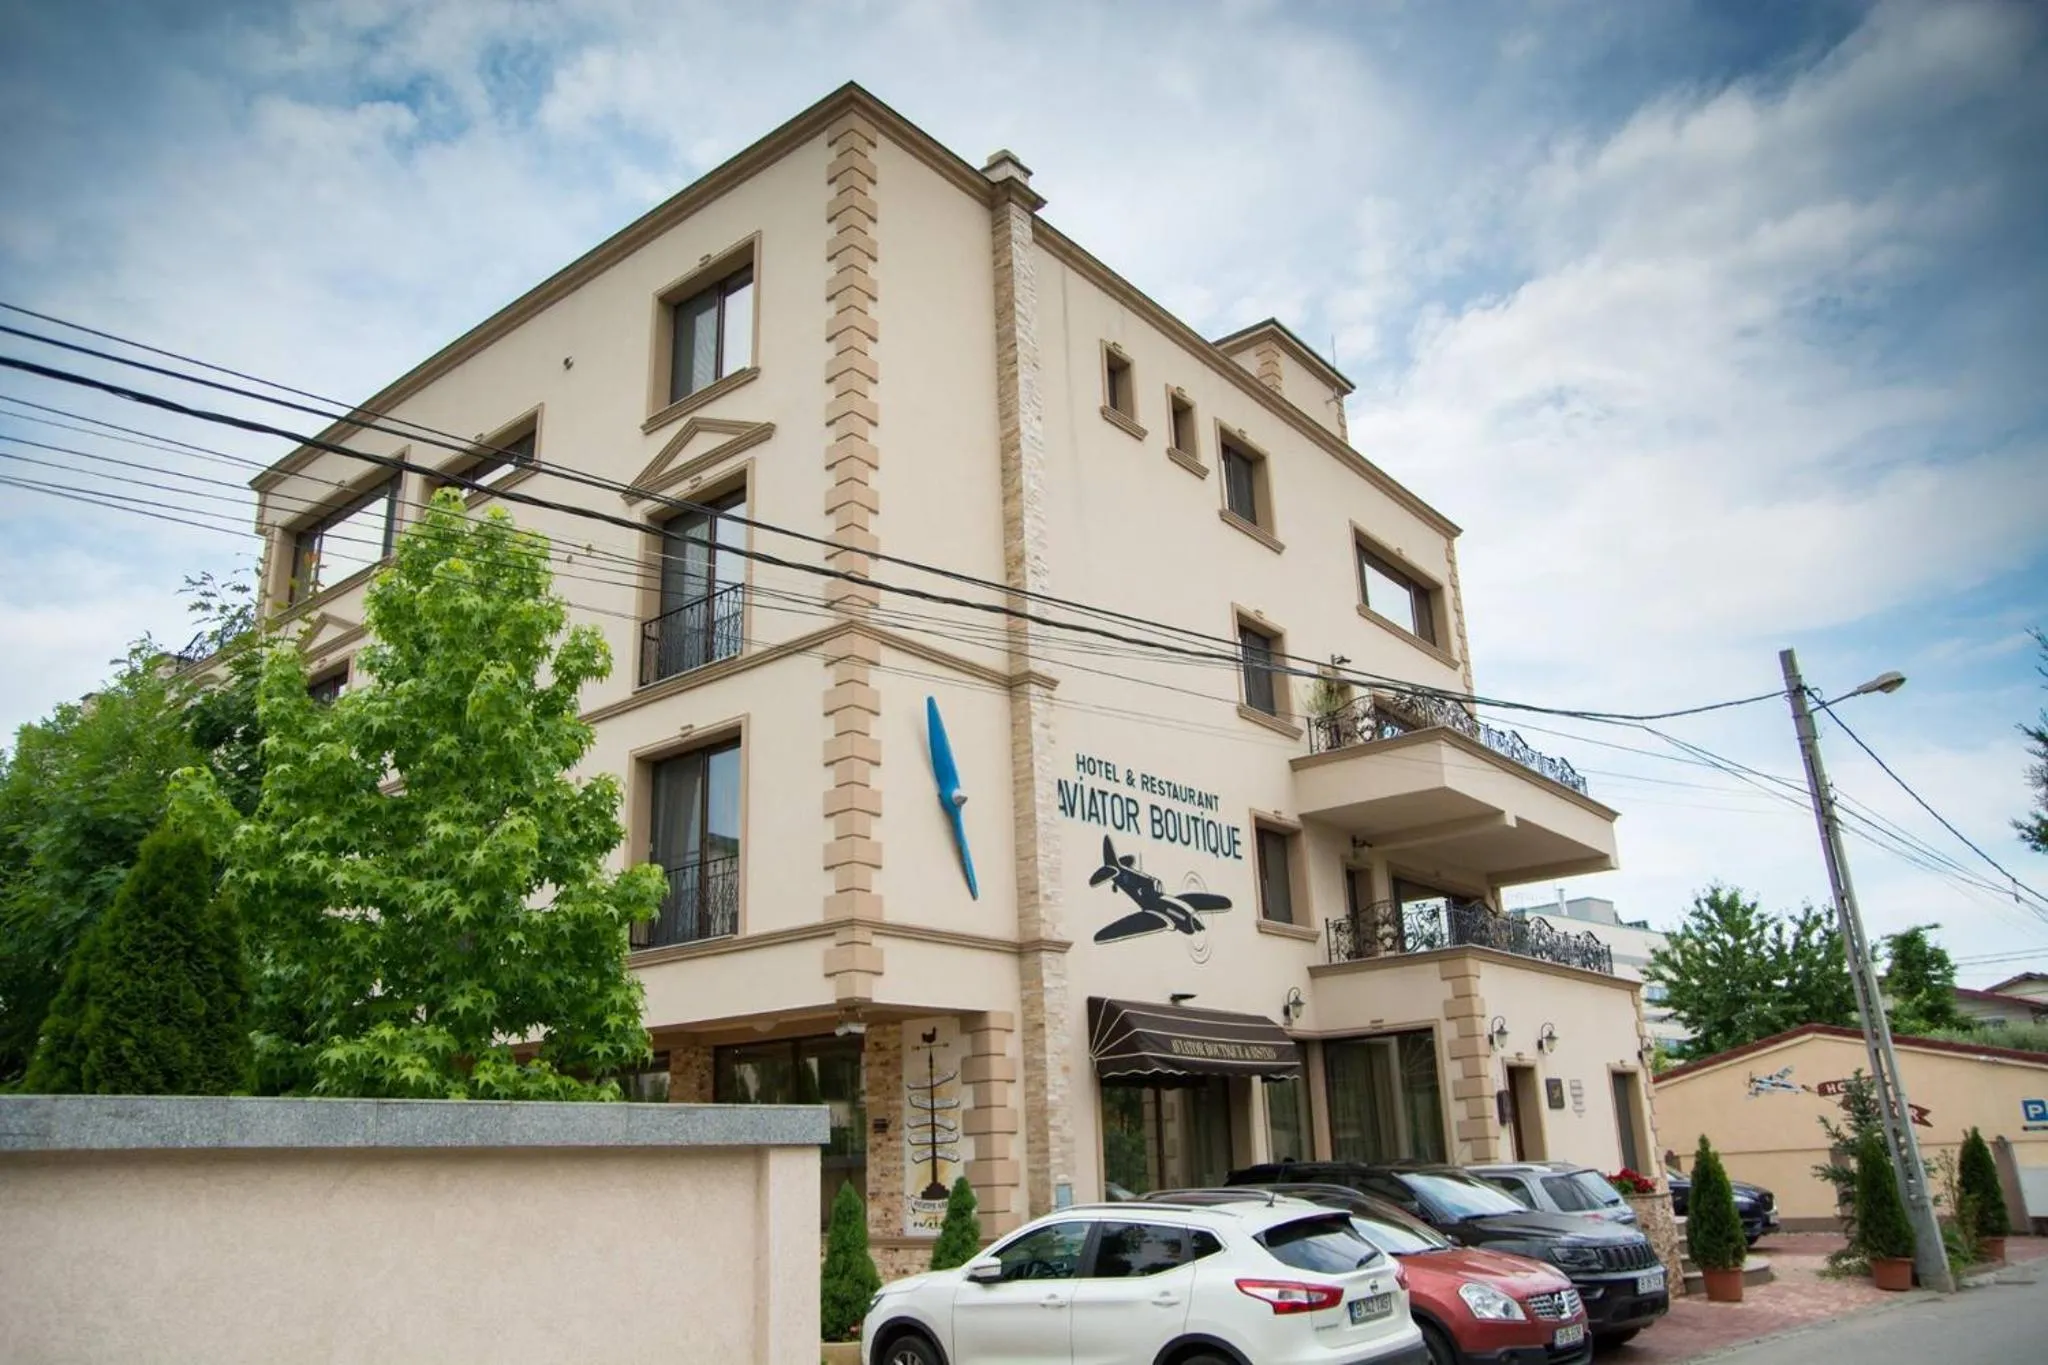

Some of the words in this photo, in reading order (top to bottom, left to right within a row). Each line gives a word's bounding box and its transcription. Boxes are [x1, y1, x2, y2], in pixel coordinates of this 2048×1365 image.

[1076, 753, 1120, 783] HOTEL
[1126, 769, 1136, 788] &
[1140, 773, 1220, 812] RESTAURANT
